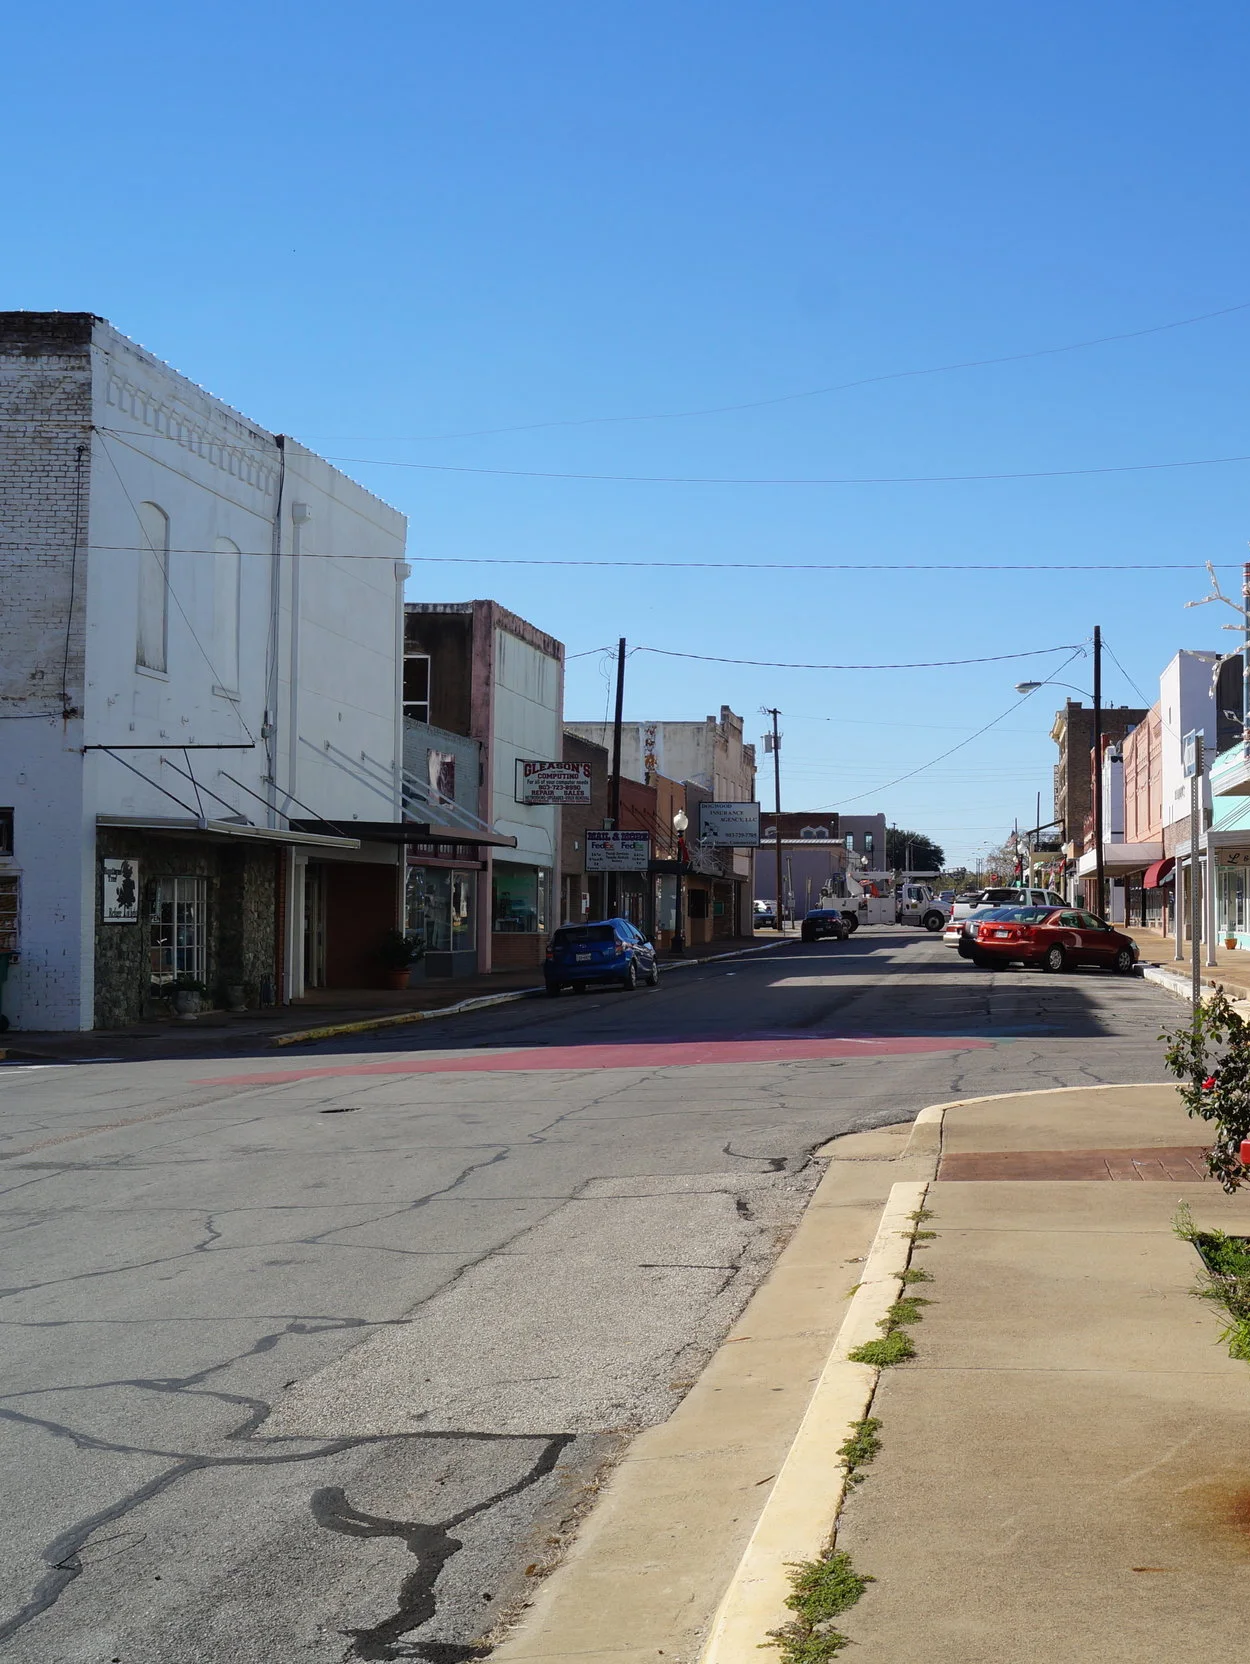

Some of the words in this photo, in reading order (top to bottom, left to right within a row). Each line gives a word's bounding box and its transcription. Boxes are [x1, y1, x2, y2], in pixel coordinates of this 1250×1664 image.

[524, 763, 591, 778] GLEASON'S
[587, 832, 611, 840] MAIL
[612, 832, 620, 841] &
[620, 832, 648, 841] MORE
